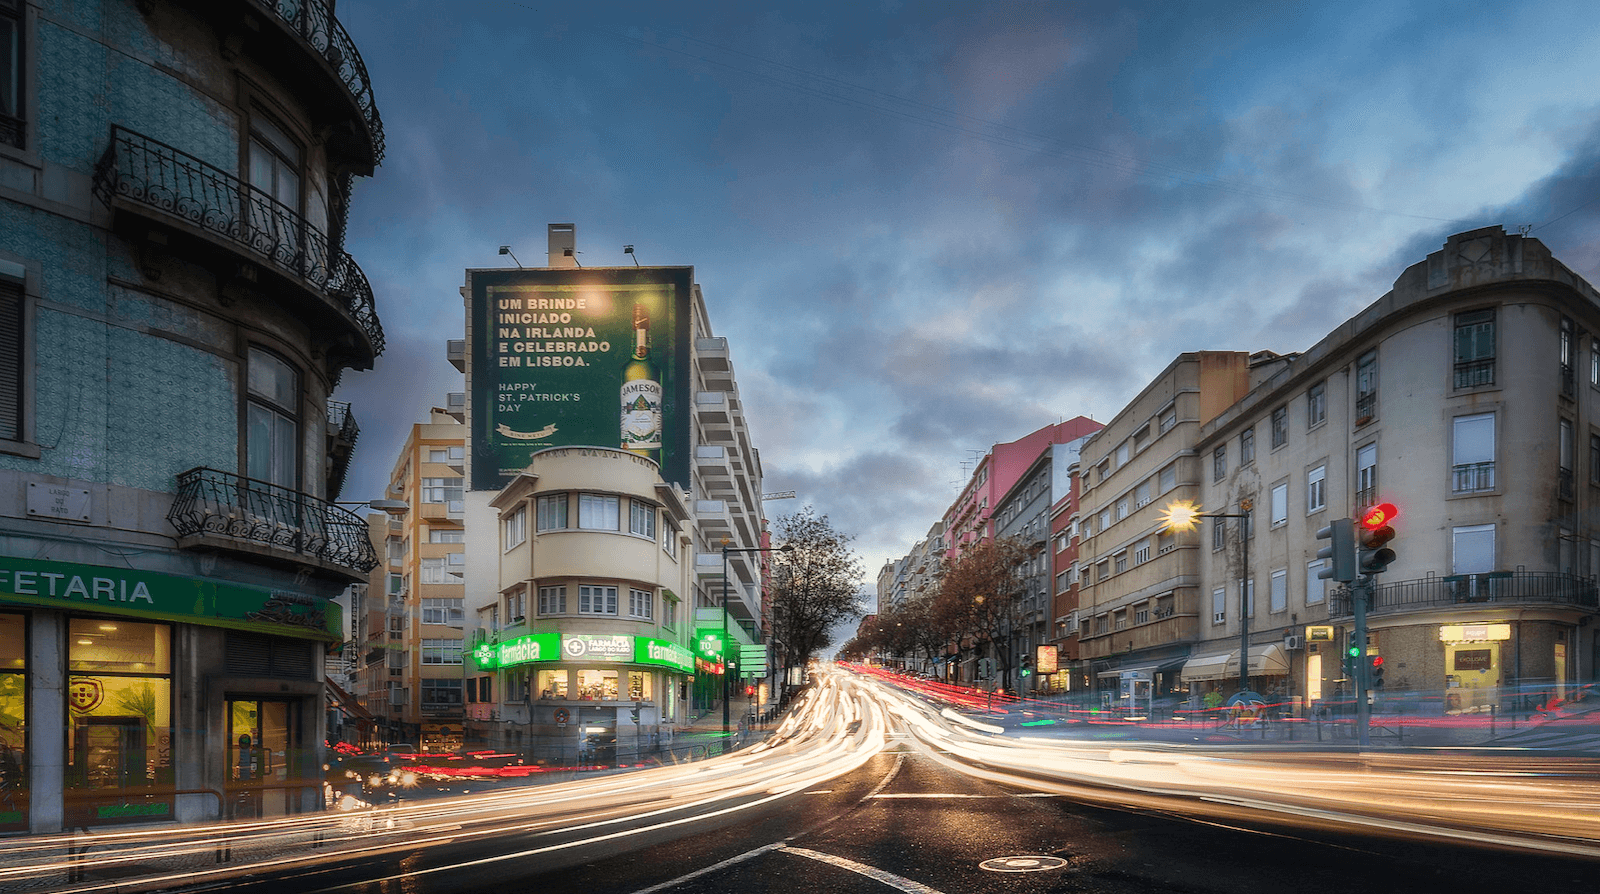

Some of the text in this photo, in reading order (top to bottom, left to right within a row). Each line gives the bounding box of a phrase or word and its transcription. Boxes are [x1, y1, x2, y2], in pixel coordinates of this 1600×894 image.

[499, 298, 586, 310] UM BRINDE
[500, 313, 571, 324] INICIADO
[499, 327, 596, 338] NA IRLANDA
[499, 341, 610, 352] E CELEBRADO
[499, 356, 590, 367] EM LISBOA.
[498, 383, 537, 391] HAPPY
[622, 384, 660, 396] JAMESON
[499, 392, 580, 402] ST. PATRICK'S
[498, 404, 521, 412] DAY
[501, 637, 540, 665] farmácia
